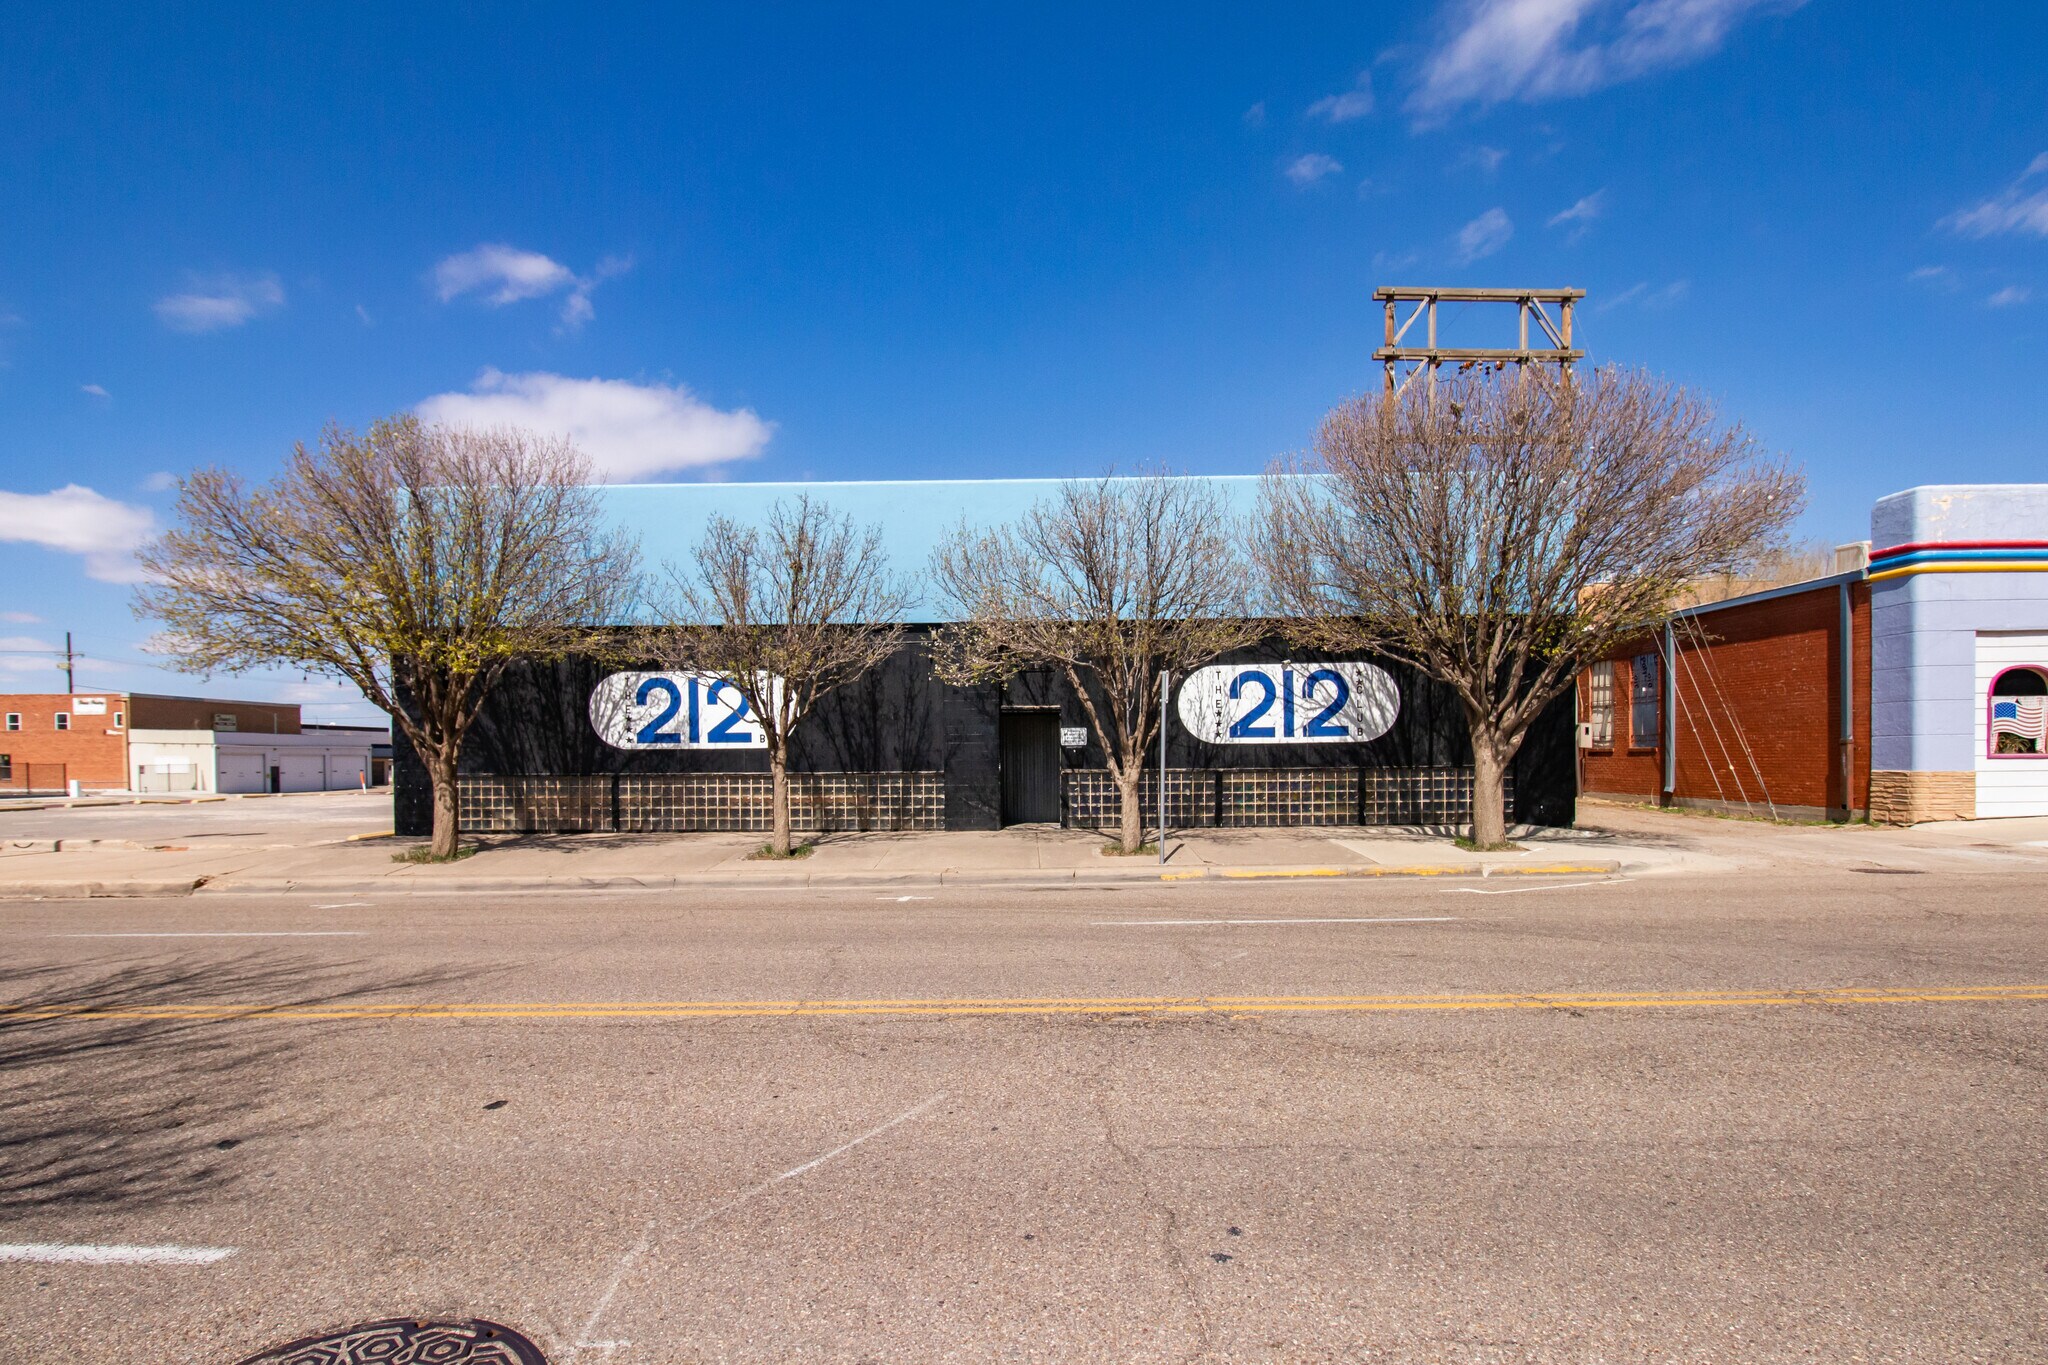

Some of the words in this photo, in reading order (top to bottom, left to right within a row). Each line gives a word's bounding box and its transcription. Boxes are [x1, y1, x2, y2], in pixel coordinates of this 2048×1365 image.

[636, 677, 752, 743] 212
[1215, 671, 1223, 709] THE
[1229, 669, 1350, 738] 212
[1356, 686, 1364, 736] CLUB
